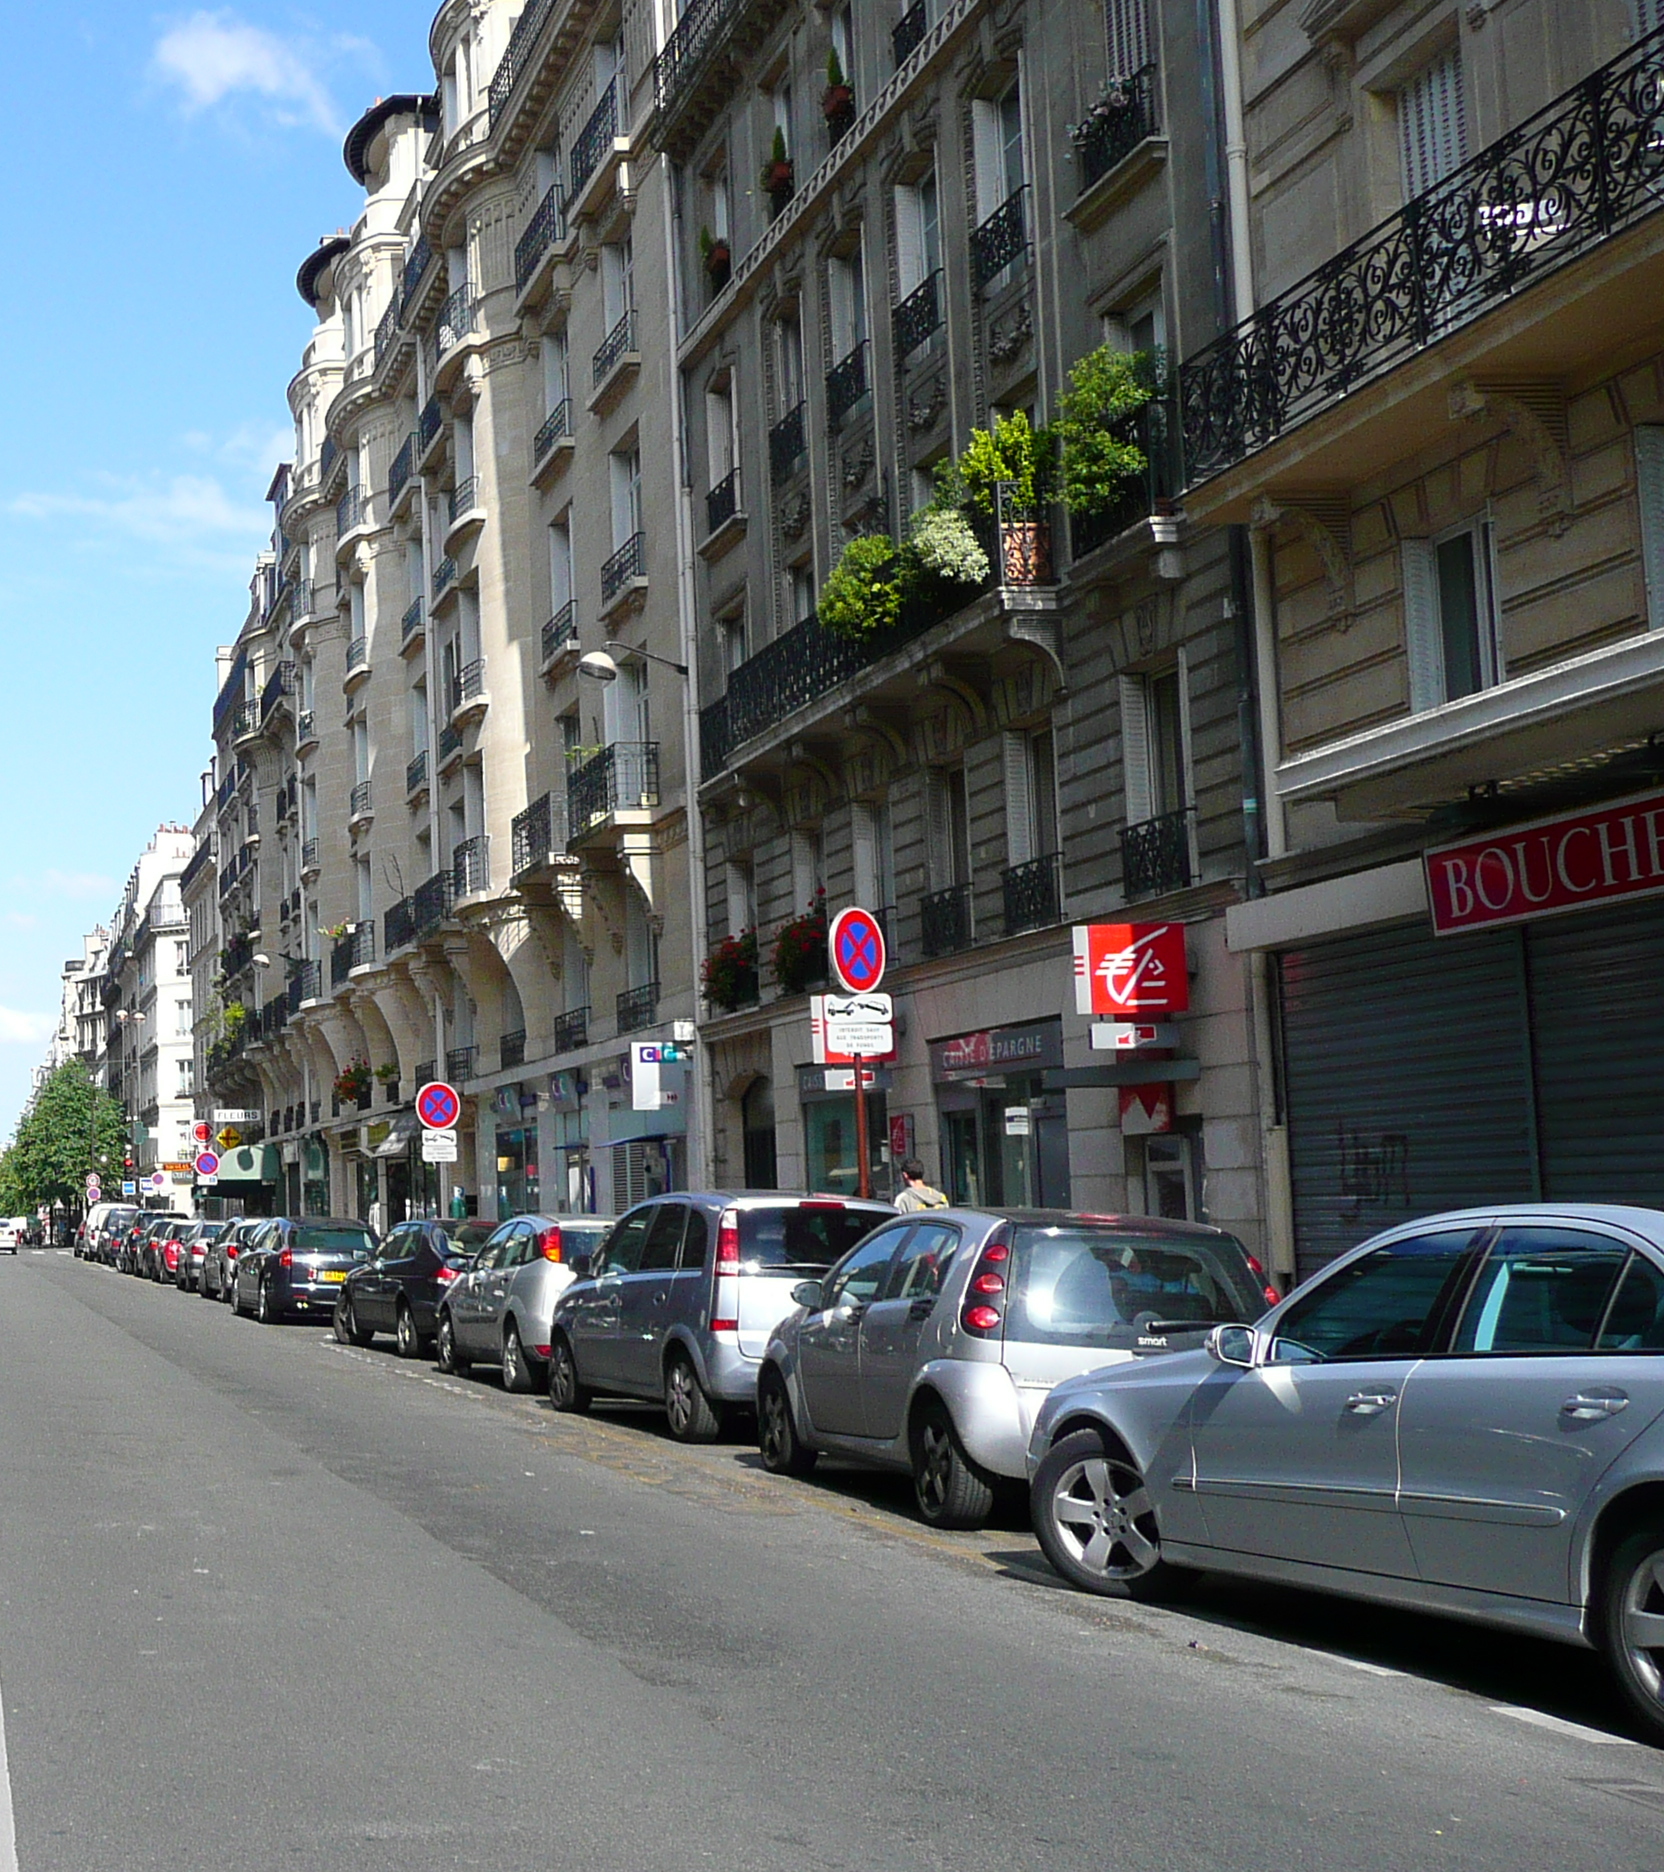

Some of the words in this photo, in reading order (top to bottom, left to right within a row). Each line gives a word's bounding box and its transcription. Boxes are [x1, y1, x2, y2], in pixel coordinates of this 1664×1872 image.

[1442, 808, 1664, 918] BOUCHE
[218, 1111, 258, 1120] FLEURS
[1137, 1336, 1168, 1346] smart
